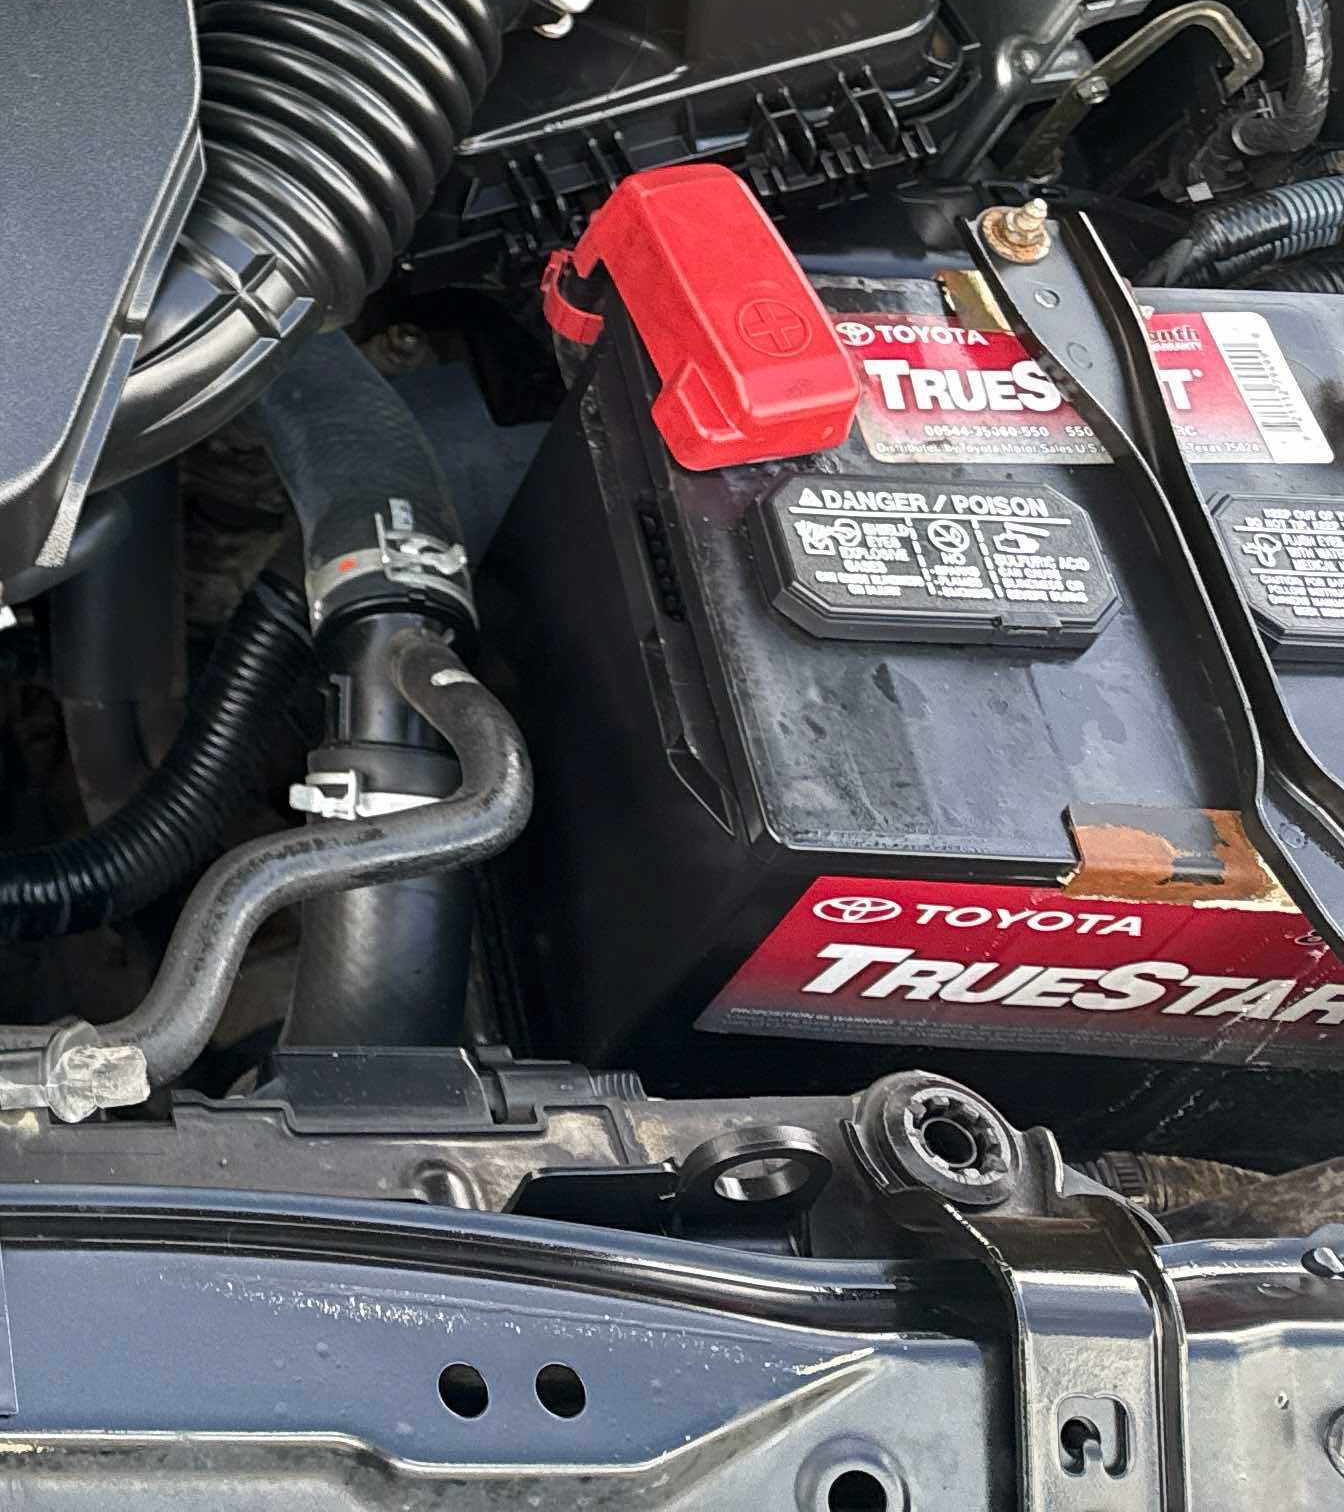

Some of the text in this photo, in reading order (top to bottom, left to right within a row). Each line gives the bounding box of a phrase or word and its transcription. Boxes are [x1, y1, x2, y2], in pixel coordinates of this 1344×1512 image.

[875, 325, 990, 345] TOYOTA
[821, 489, 929, 513] DANGER
[950, 495, 1049, 518] POISON
[940, 551, 966, 565] NO
[914, 903, 1143, 937] TOYOTA
